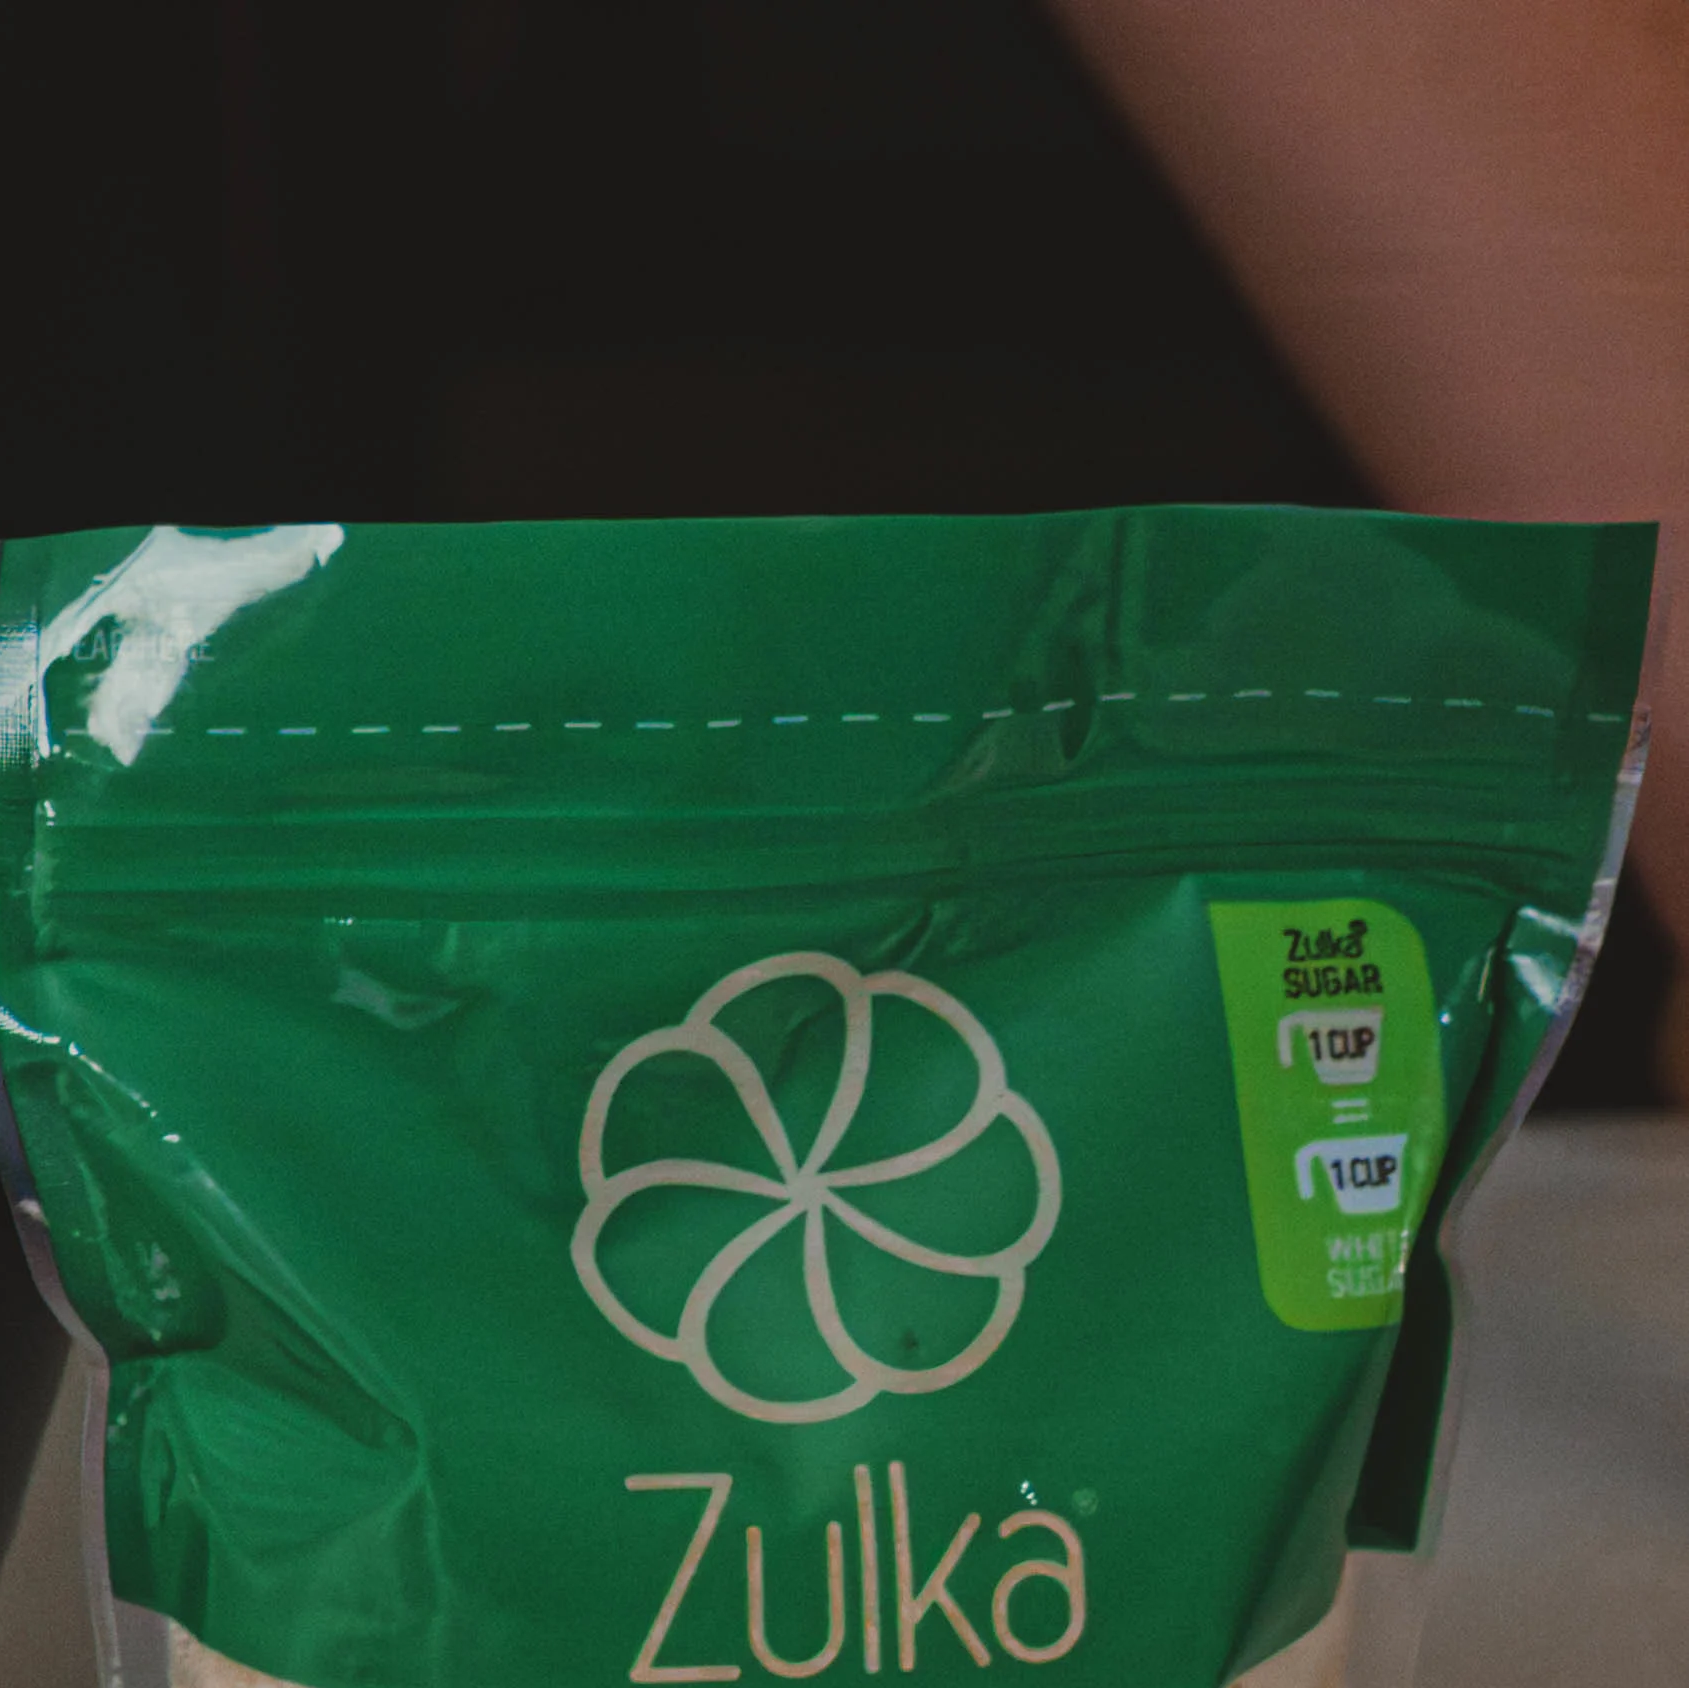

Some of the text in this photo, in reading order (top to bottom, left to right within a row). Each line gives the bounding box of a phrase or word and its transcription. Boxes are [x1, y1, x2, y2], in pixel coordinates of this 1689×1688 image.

[1284, 964, 1383, 998] SUGAR
[1310, 1026, 1375, 1060] 1 CUP
[1332, 1154, 1396, 1190] 1 CUP
[625, 1459, 1085, 1683] Zulka
